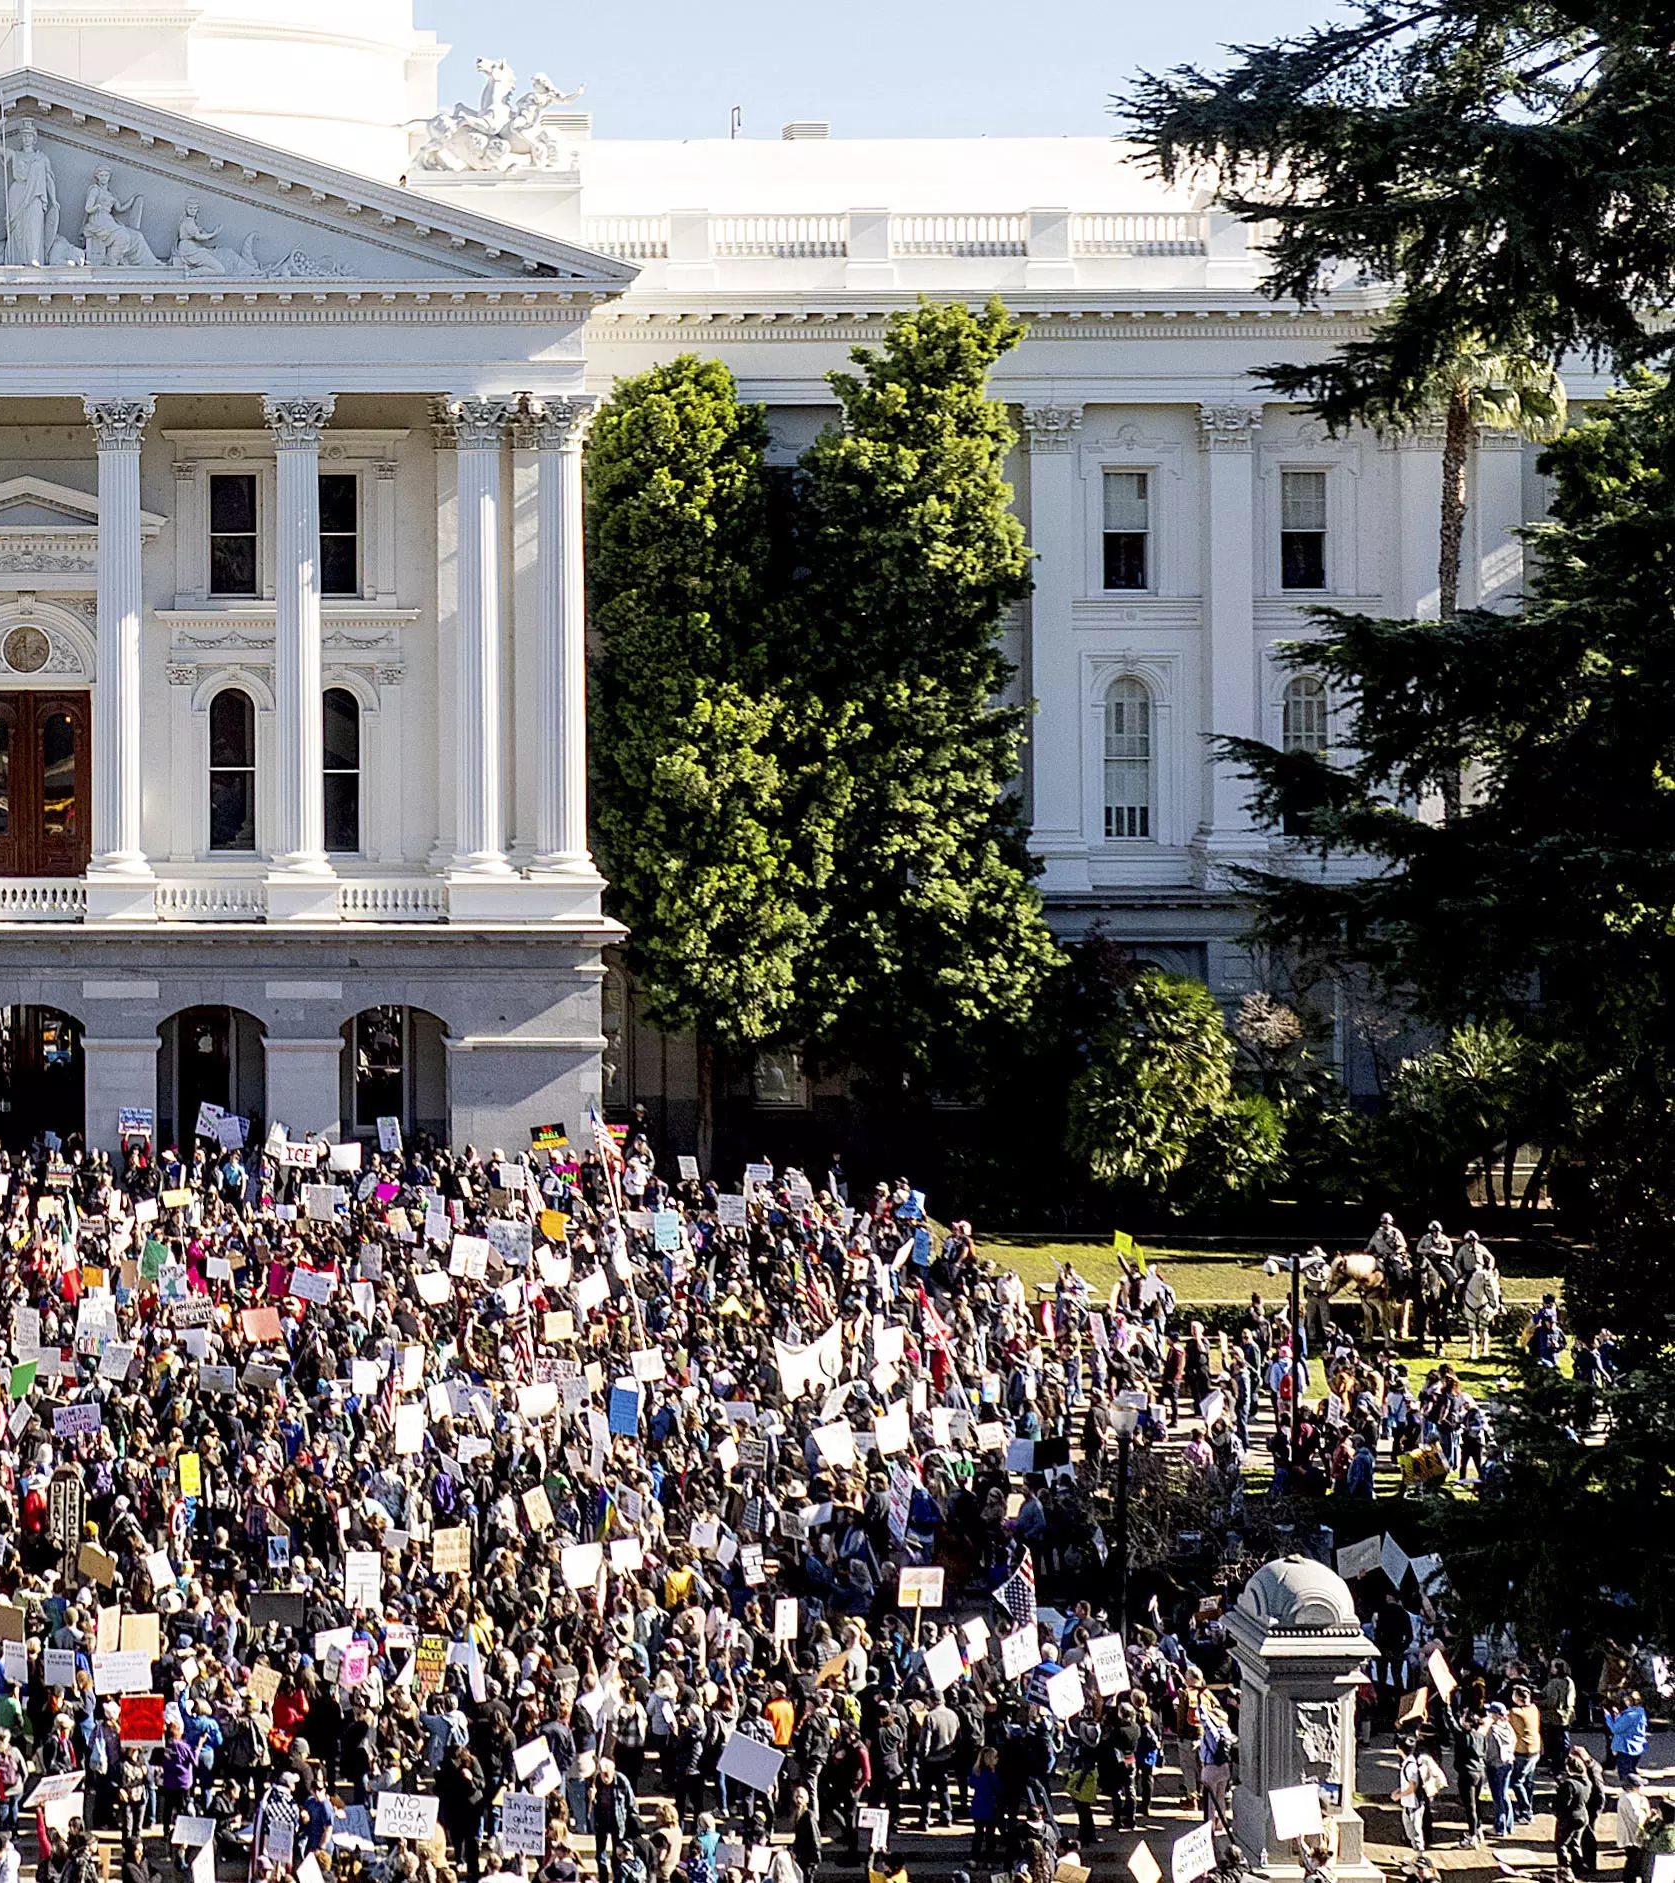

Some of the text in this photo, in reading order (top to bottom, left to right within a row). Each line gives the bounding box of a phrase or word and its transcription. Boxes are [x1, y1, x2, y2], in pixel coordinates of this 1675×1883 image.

[285, 1147, 312, 1163] ICE
[1096, 1653, 1122, 1666] TRUMP
[1100, 1671, 1125, 1684] MUSK
[394, 1796, 421, 1810] NO
[507, 1797, 521, 1811] In
[383, 1808, 428, 1823] MUSK
[512, 1815, 534, 1825] guts
[387, 1822, 428, 1837] COUP
[505, 1823, 543, 1837] you know
